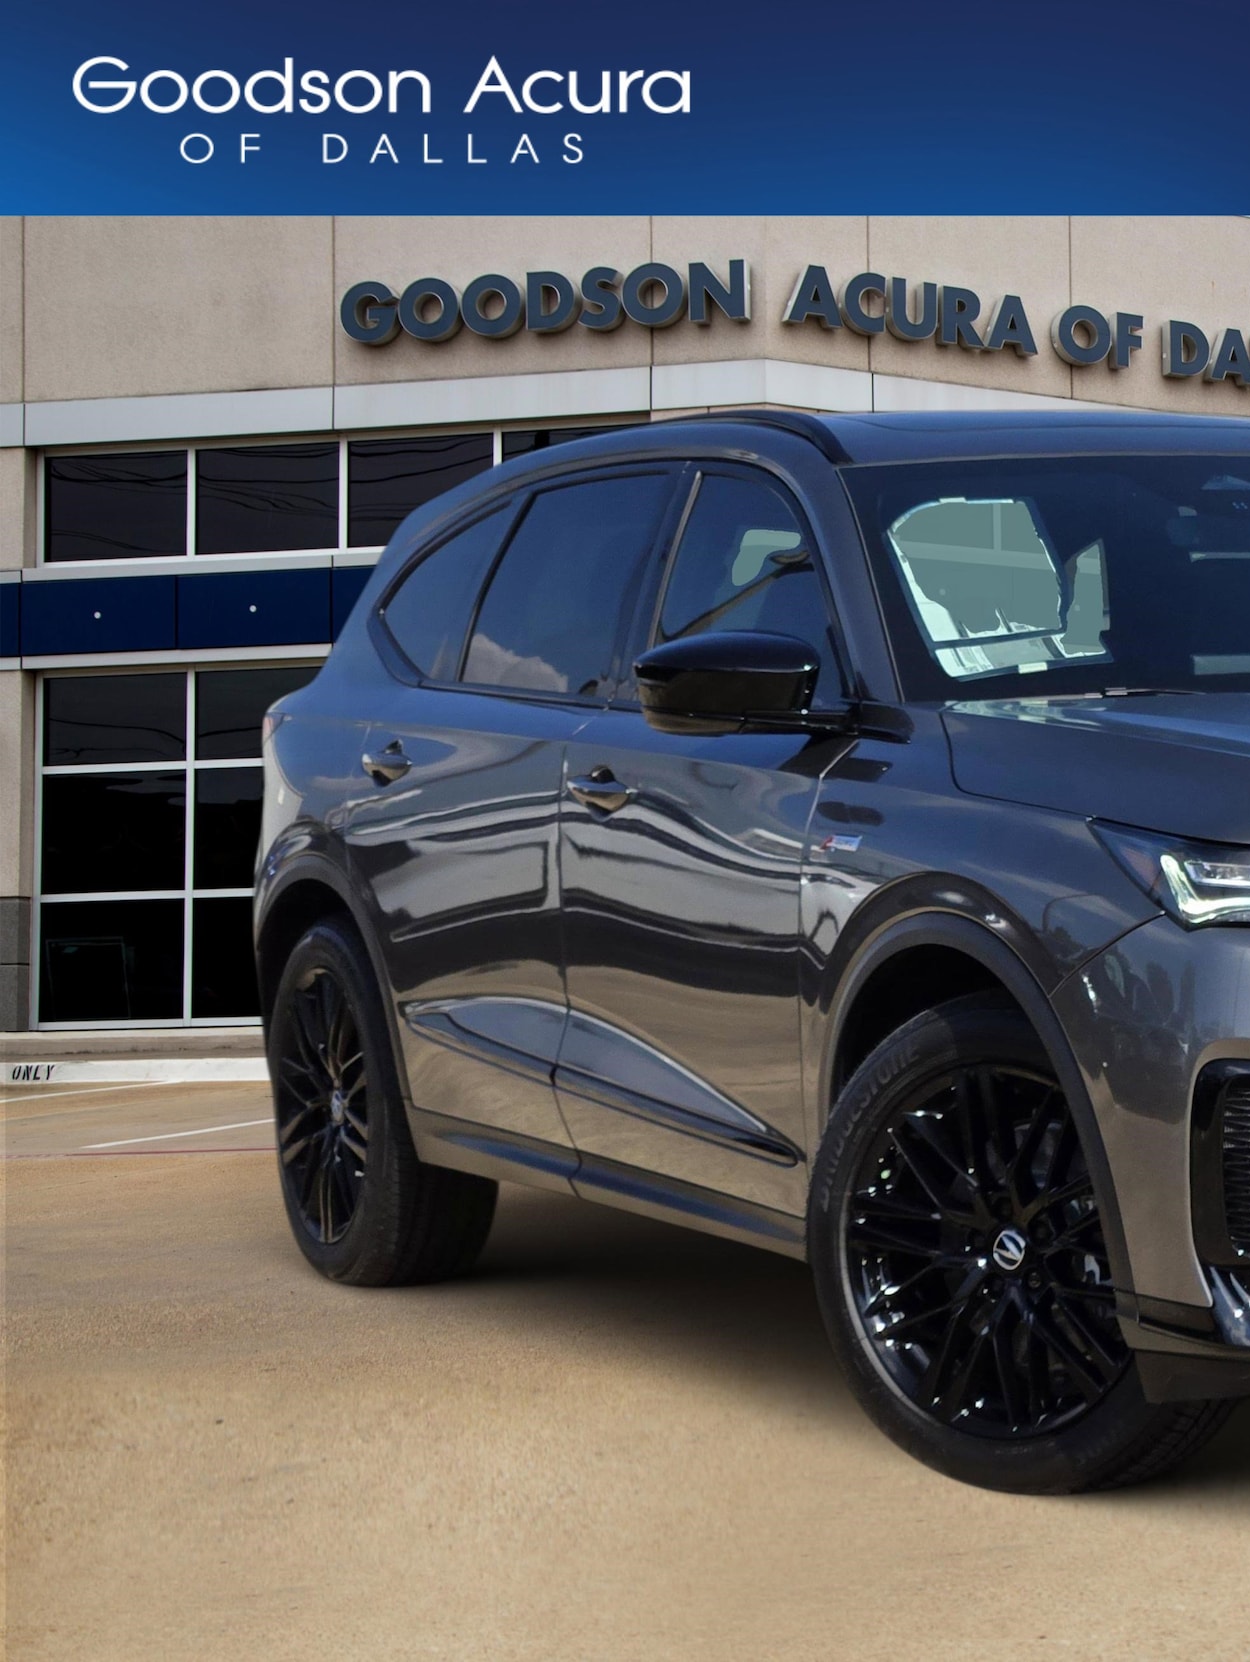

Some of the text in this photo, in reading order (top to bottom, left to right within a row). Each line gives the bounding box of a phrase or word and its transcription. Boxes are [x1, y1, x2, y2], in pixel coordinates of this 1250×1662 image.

[340, 259, 750, 346] GOODSON
[782, 264, 1038, 356] ACURA
[1051, 305, 1144, 369] OF
[12, 1064, 55, 1080] ONLY
